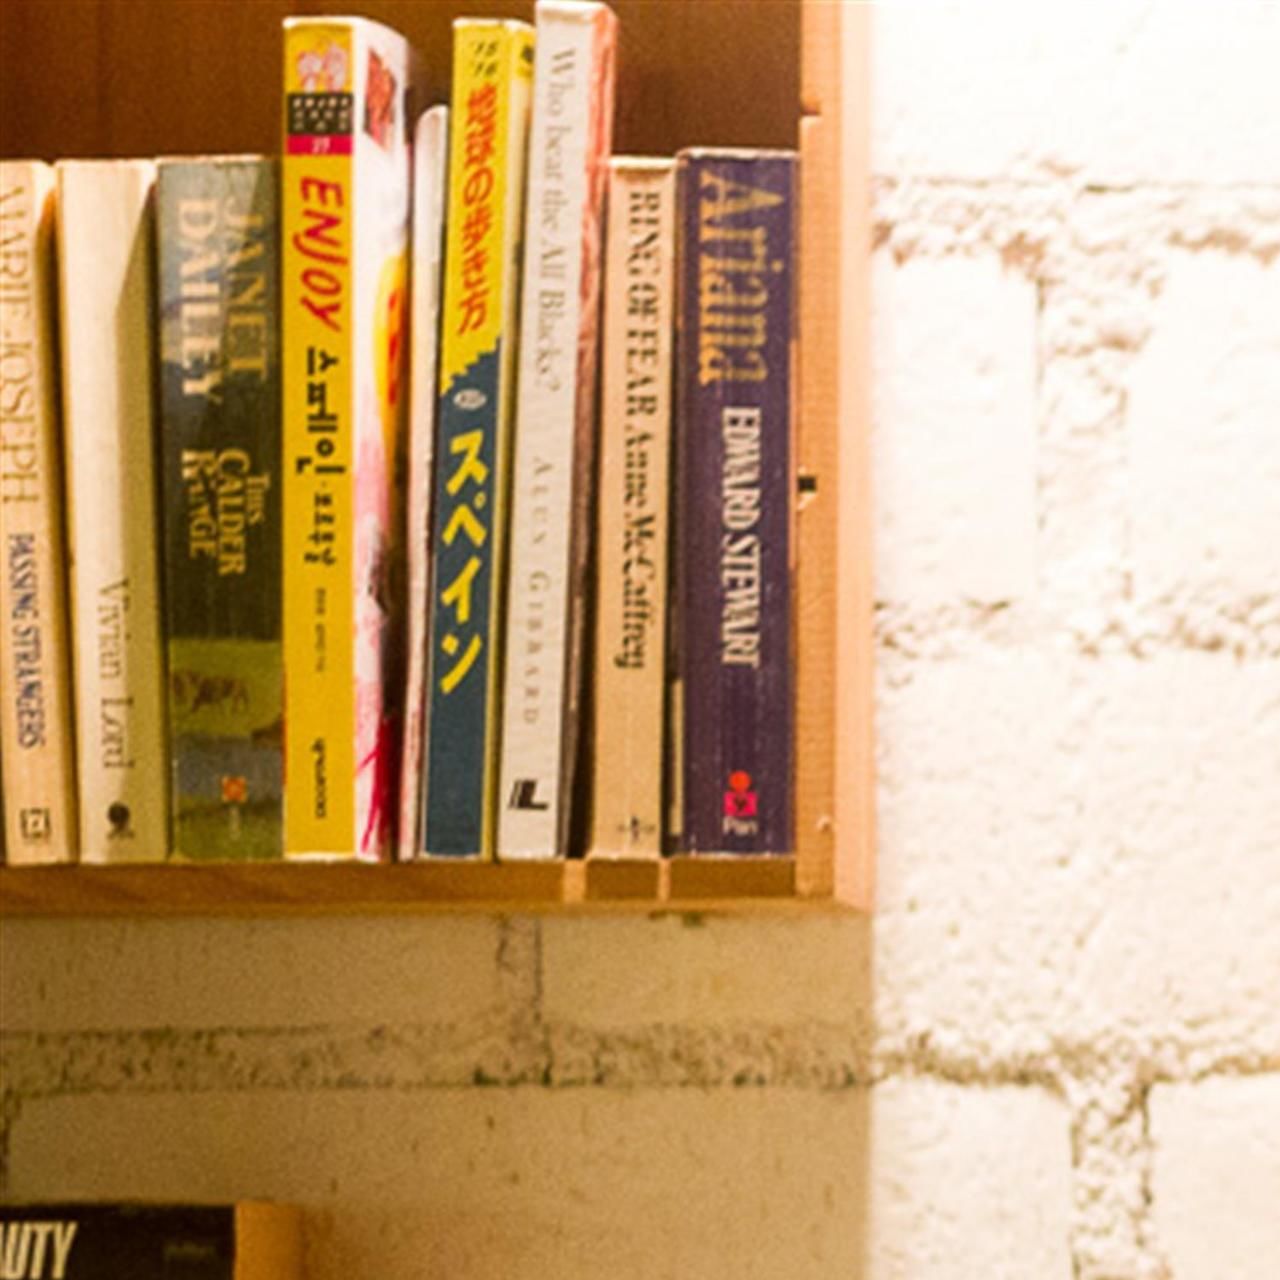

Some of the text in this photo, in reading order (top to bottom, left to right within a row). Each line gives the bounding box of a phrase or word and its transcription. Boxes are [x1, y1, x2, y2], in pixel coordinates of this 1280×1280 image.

[177, 200, 223, 402] DAILEY
[225, 201, 270, 381] JANET
[300, 178, 351, 332] ENJOY
[535, 48, 575, 392] Who beat the All Blacks?
[626, 192, 662, 277] RING
[698, 172, 784, 385] Ariana
[624, 319, 656, 415] FEAR
[182, 450, 216, 560] RANGE
[216, 450, 249, 576] CALDER
[440, 431, 490, 694] スペイン
[722, 407, 761, 668] EDWARD STEWART
[12, 532, 47, 748] PASSING STRANGERS
[99, 577, 135, 769] Vivian Lord
[0, 1222, 78, 1280] UTY
